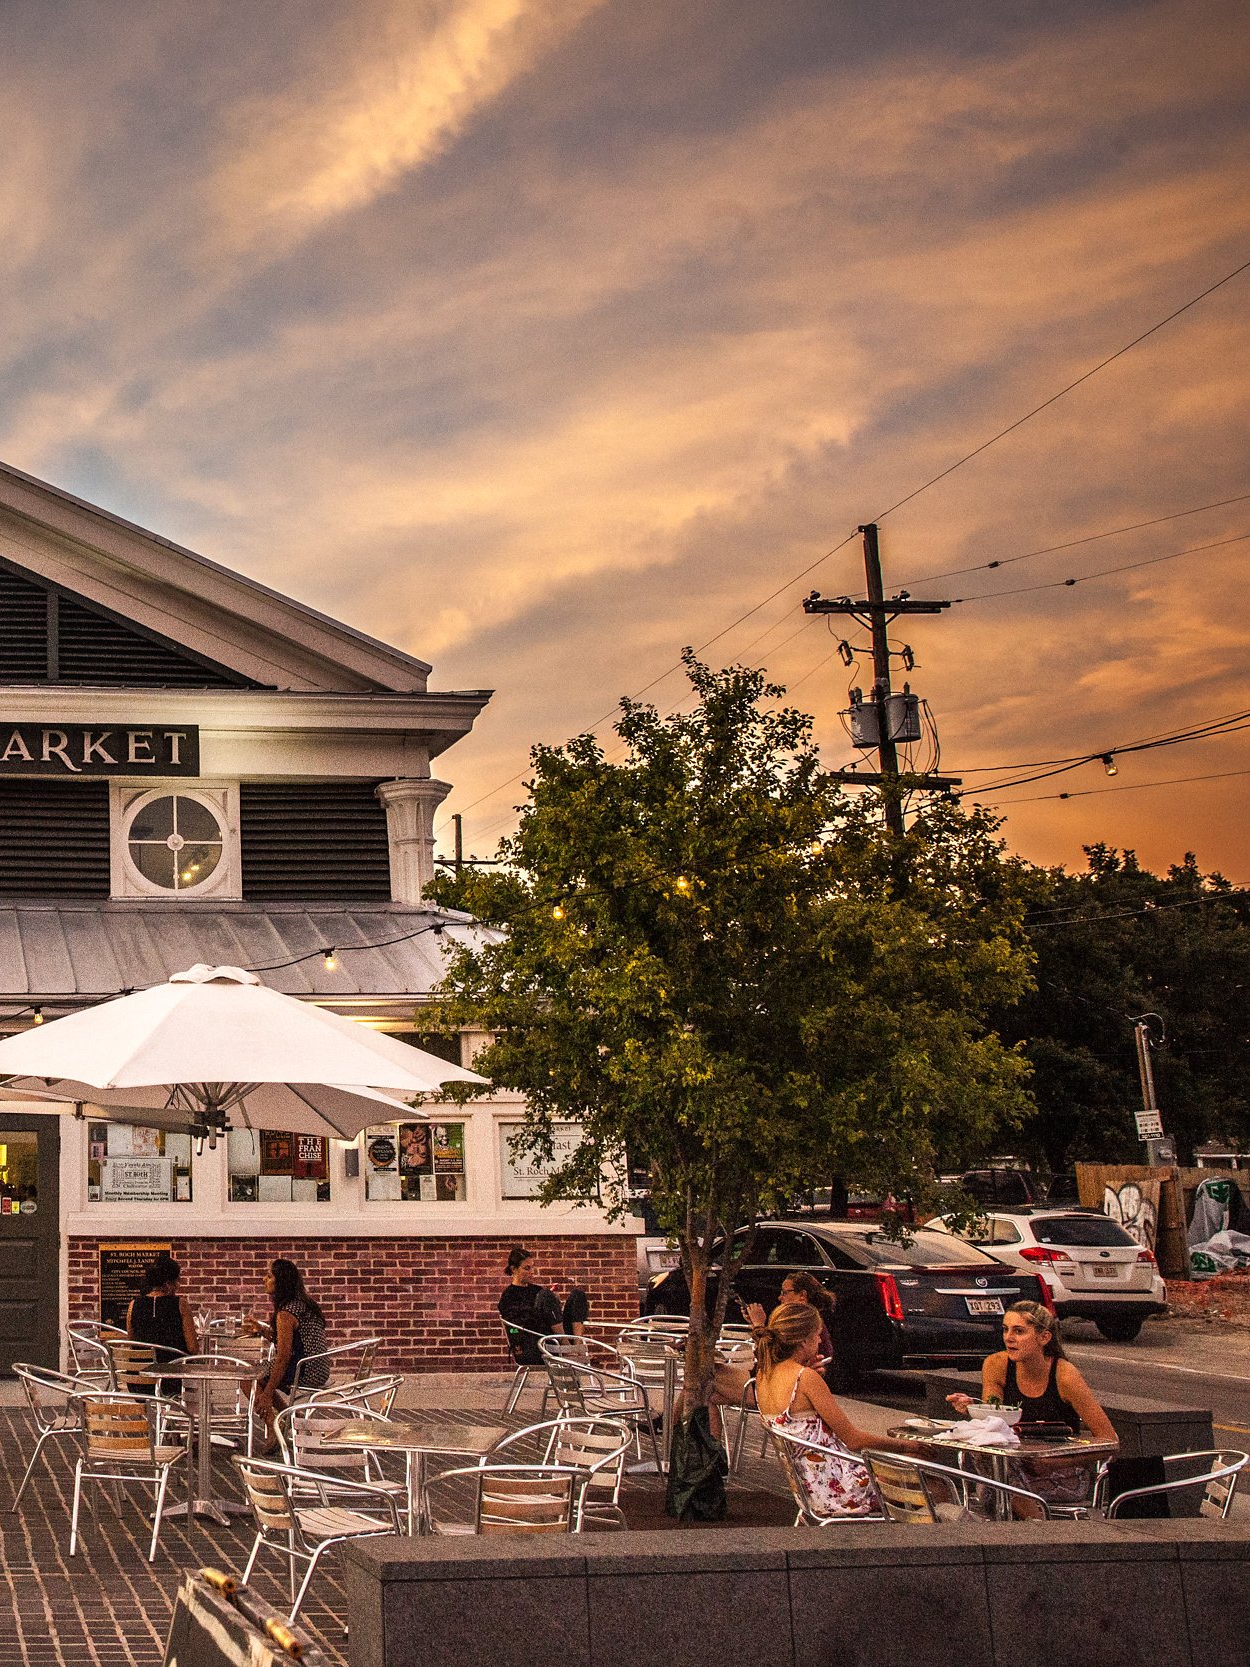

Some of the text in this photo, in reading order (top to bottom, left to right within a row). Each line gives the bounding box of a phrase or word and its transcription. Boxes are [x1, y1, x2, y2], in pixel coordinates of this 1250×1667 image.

[513, 1167, 525, 1176] St.
[527, 1166, 549, 1176] Roch
[986, 1301, 1001, 1311] 293
